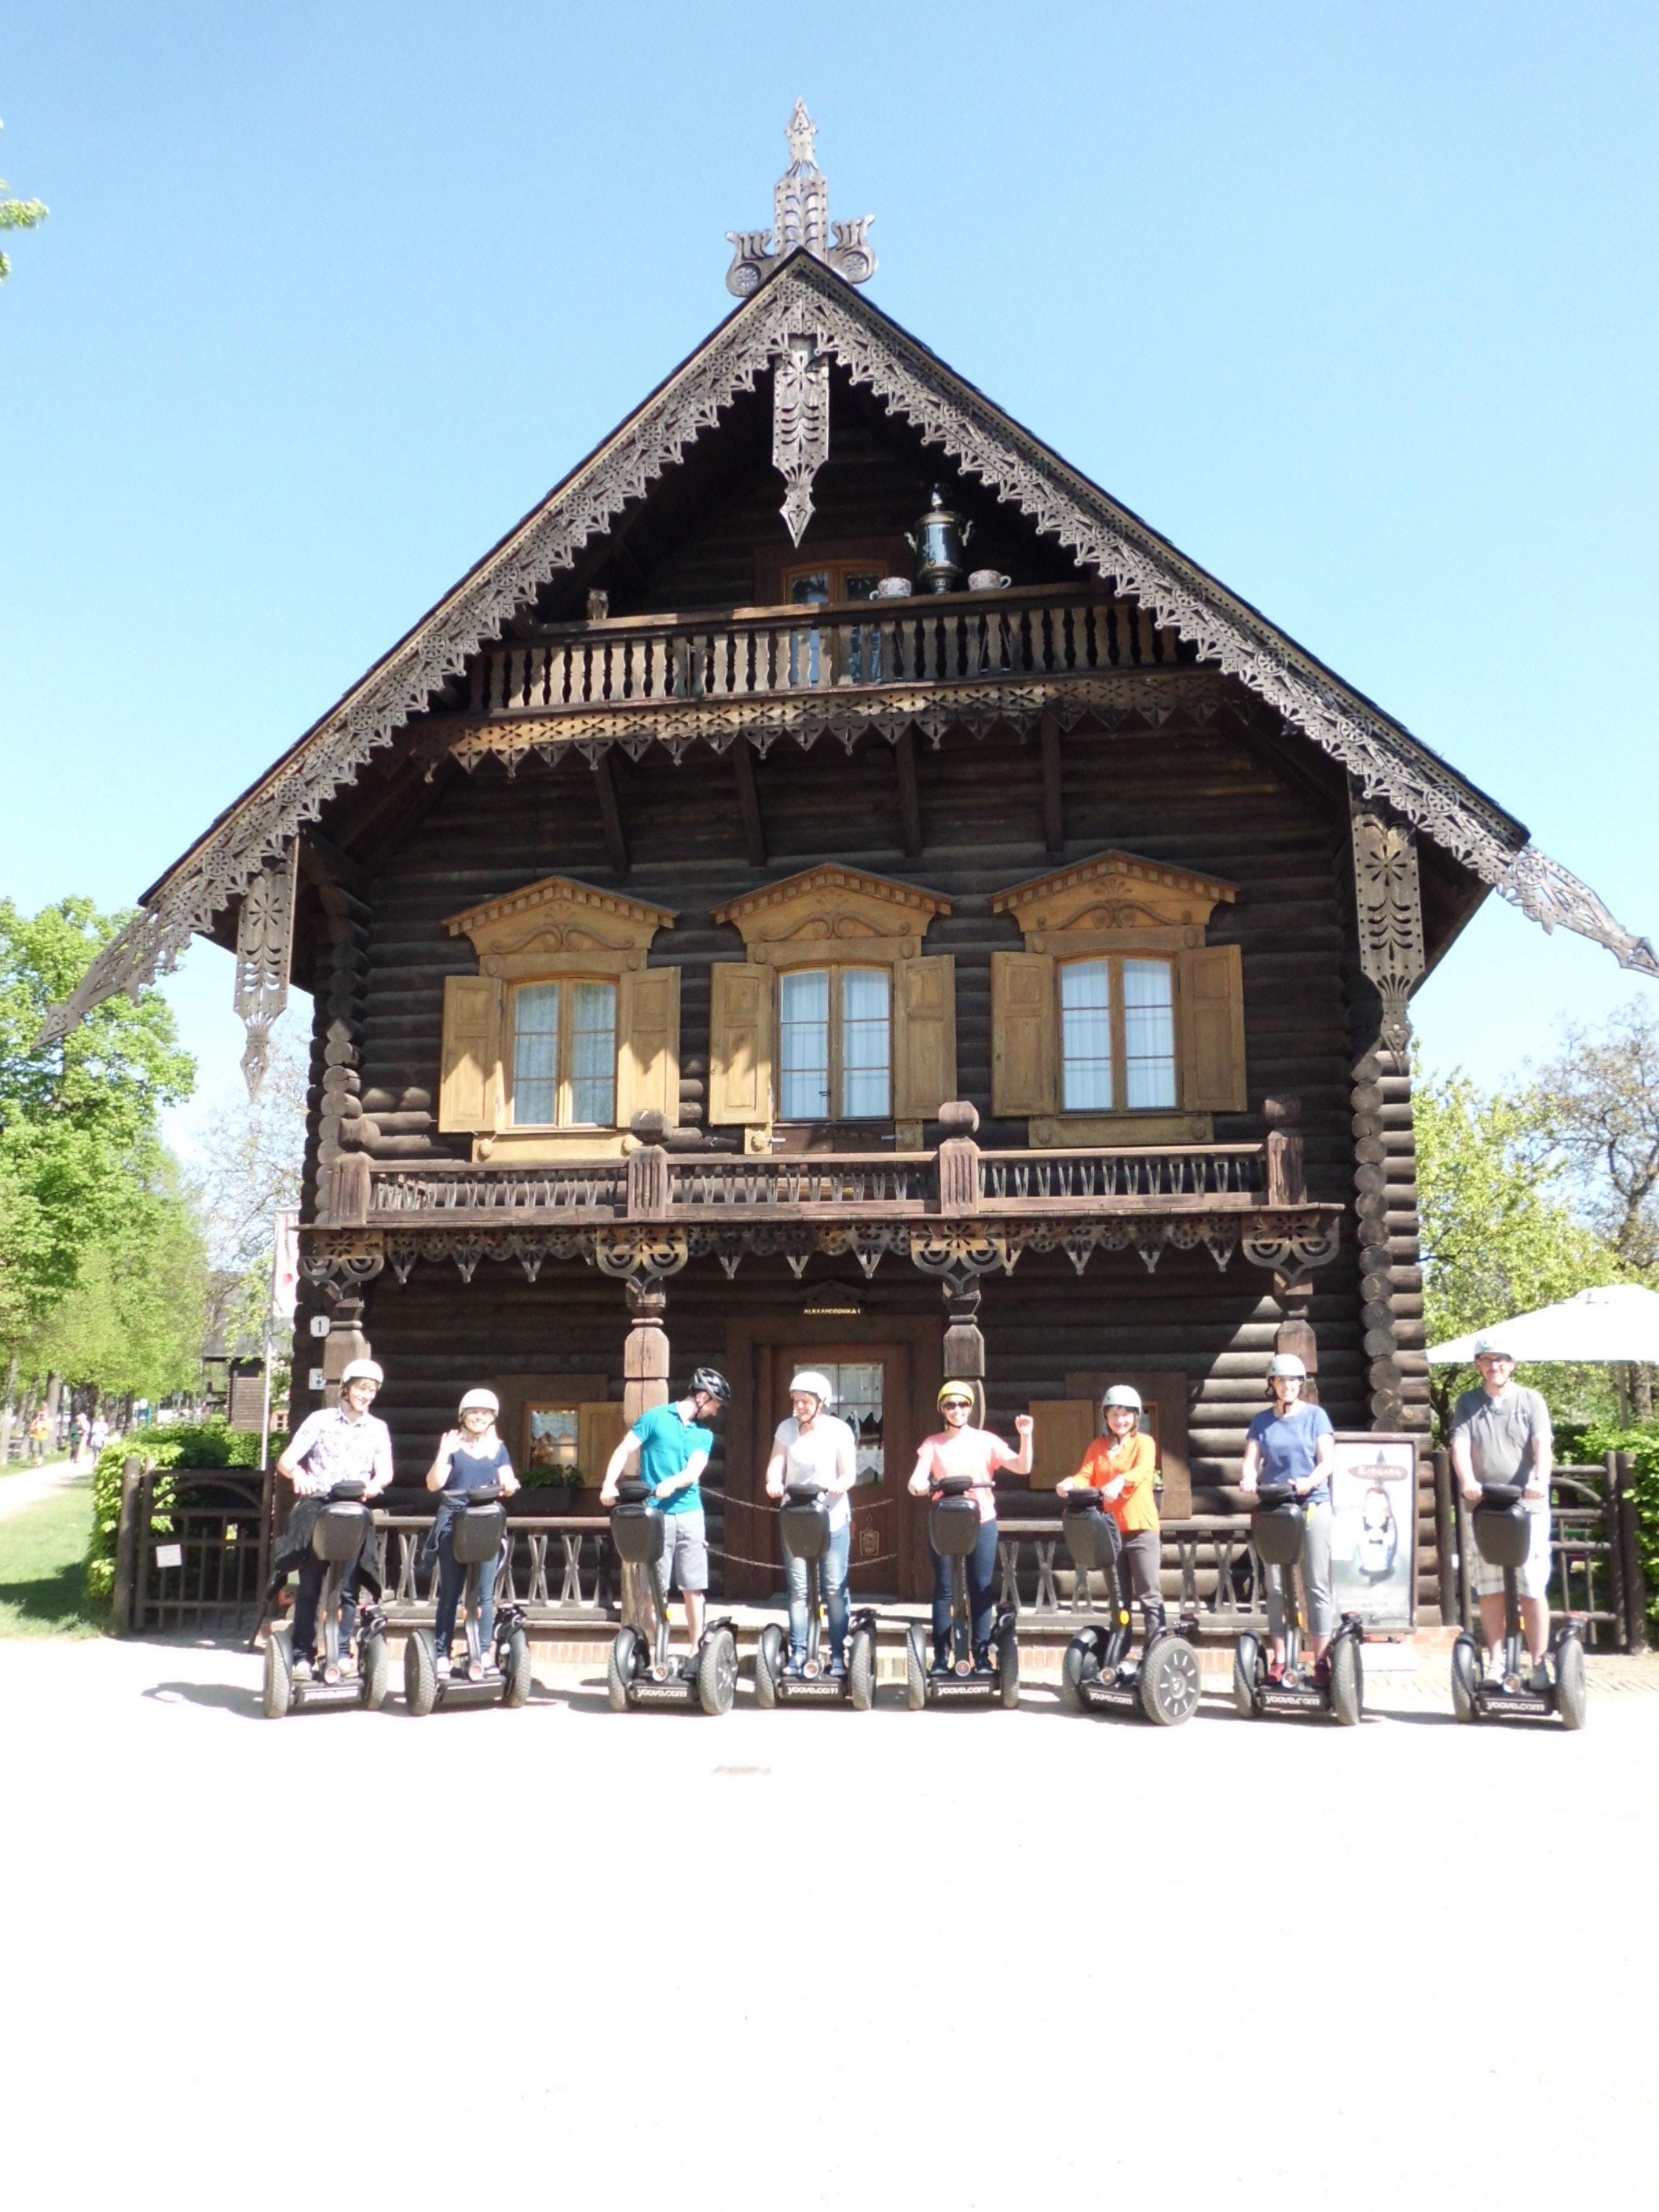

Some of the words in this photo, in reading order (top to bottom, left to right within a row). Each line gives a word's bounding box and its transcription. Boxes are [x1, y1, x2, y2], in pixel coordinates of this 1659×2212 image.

[787, 1686, 838, 1695] yoove.com
[938, 1686, 990, 1696] yoove.com
[1265, 1695, 1320, 1705] yoove.com
[1486, 1701, 1545, 1711] yoove.com
